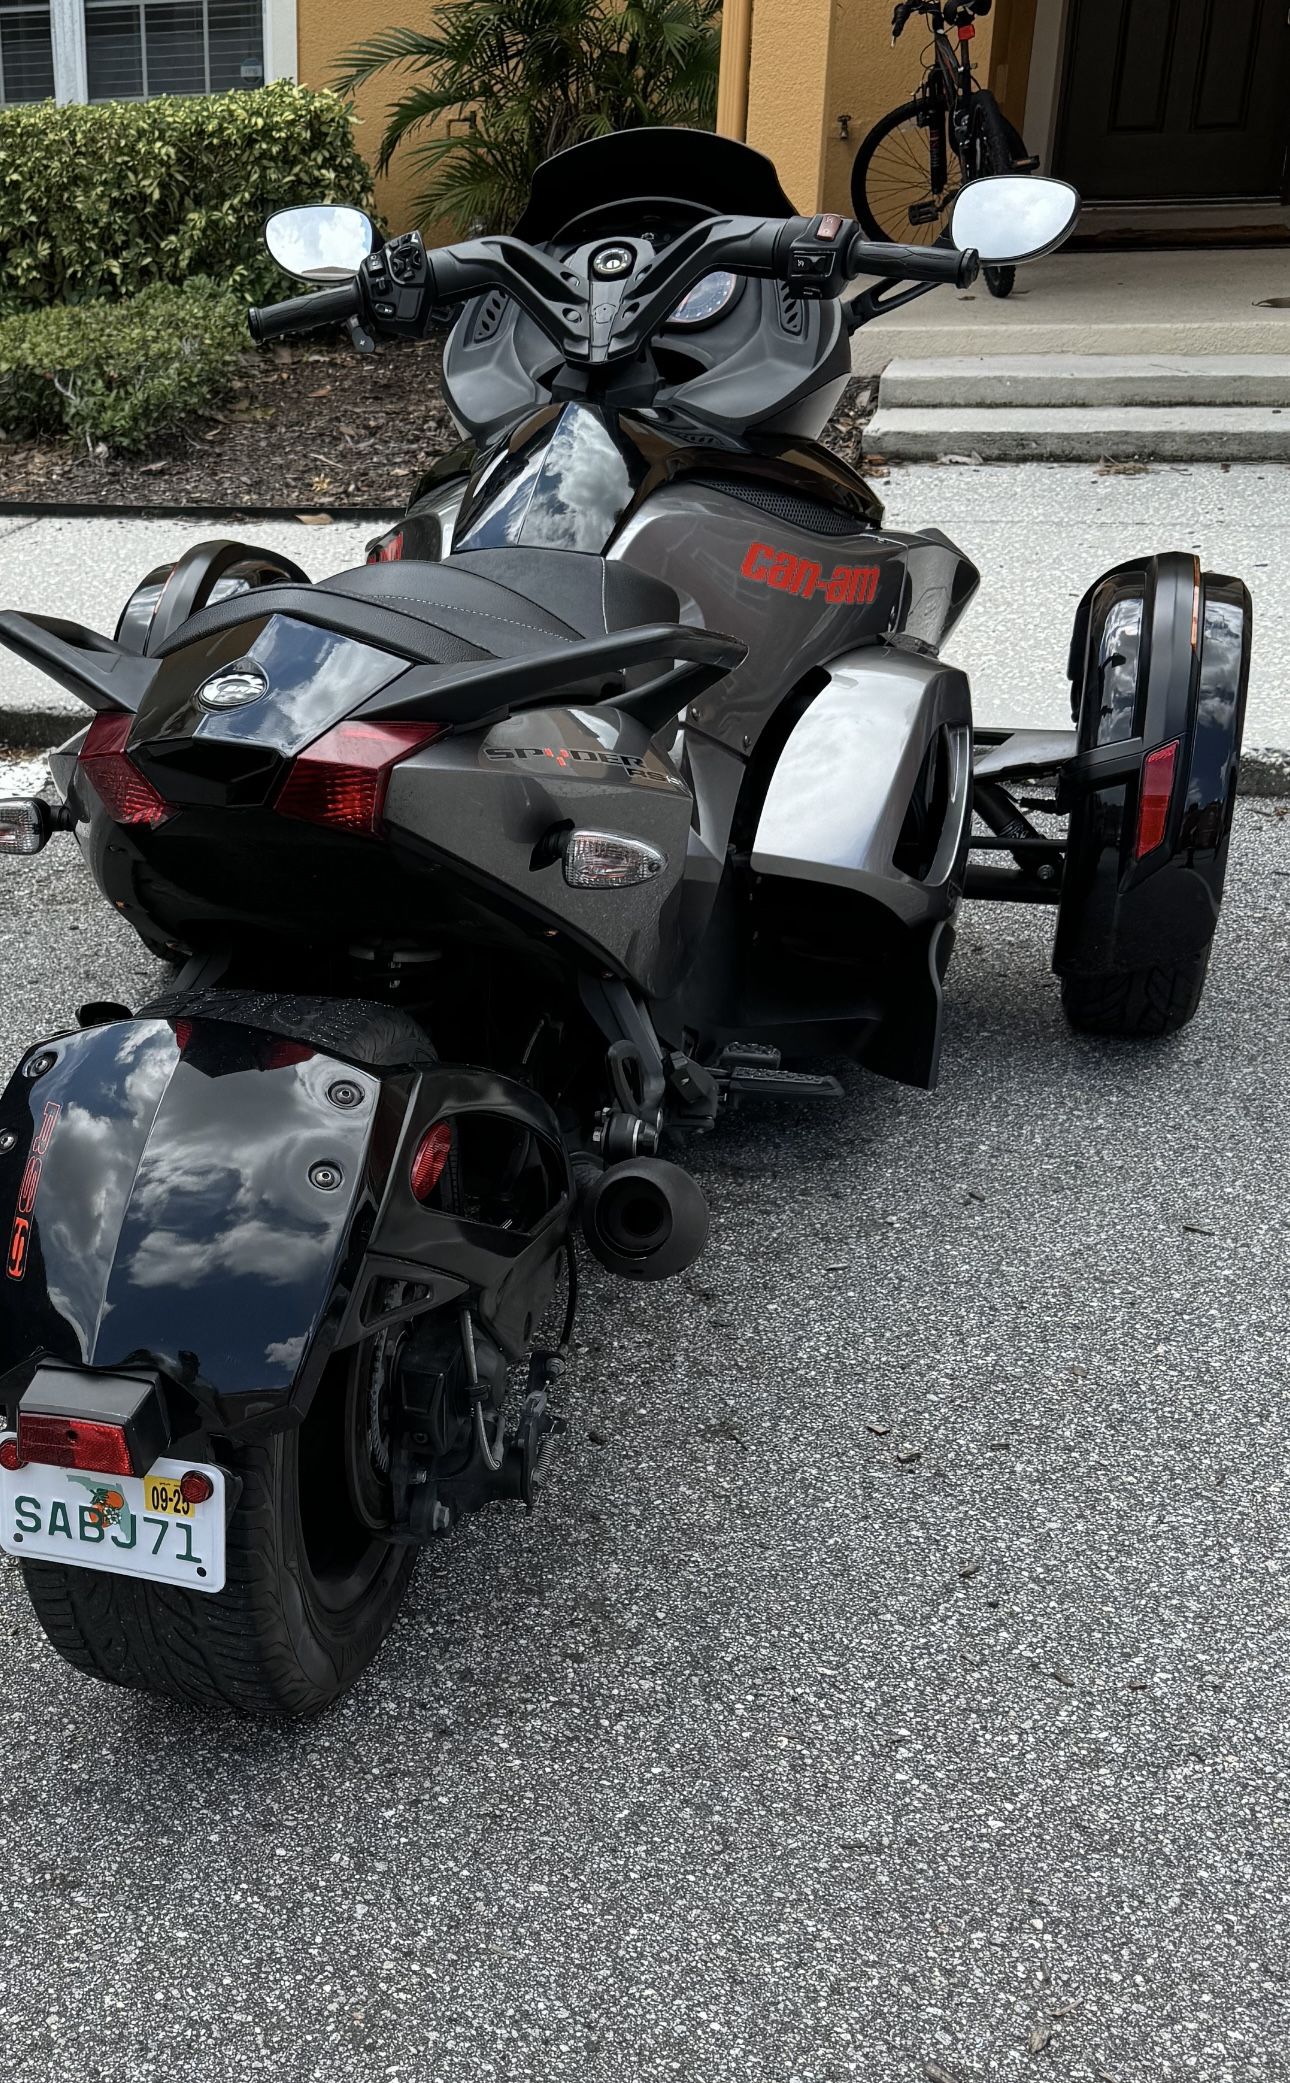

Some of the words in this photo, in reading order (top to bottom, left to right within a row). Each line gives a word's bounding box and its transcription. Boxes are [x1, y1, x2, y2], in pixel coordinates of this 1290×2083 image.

[741, 541, 880, 604] can-am
[485, 748, 648, 768] SPYDER
[14, 1495, 202, 1564] SABJ71
